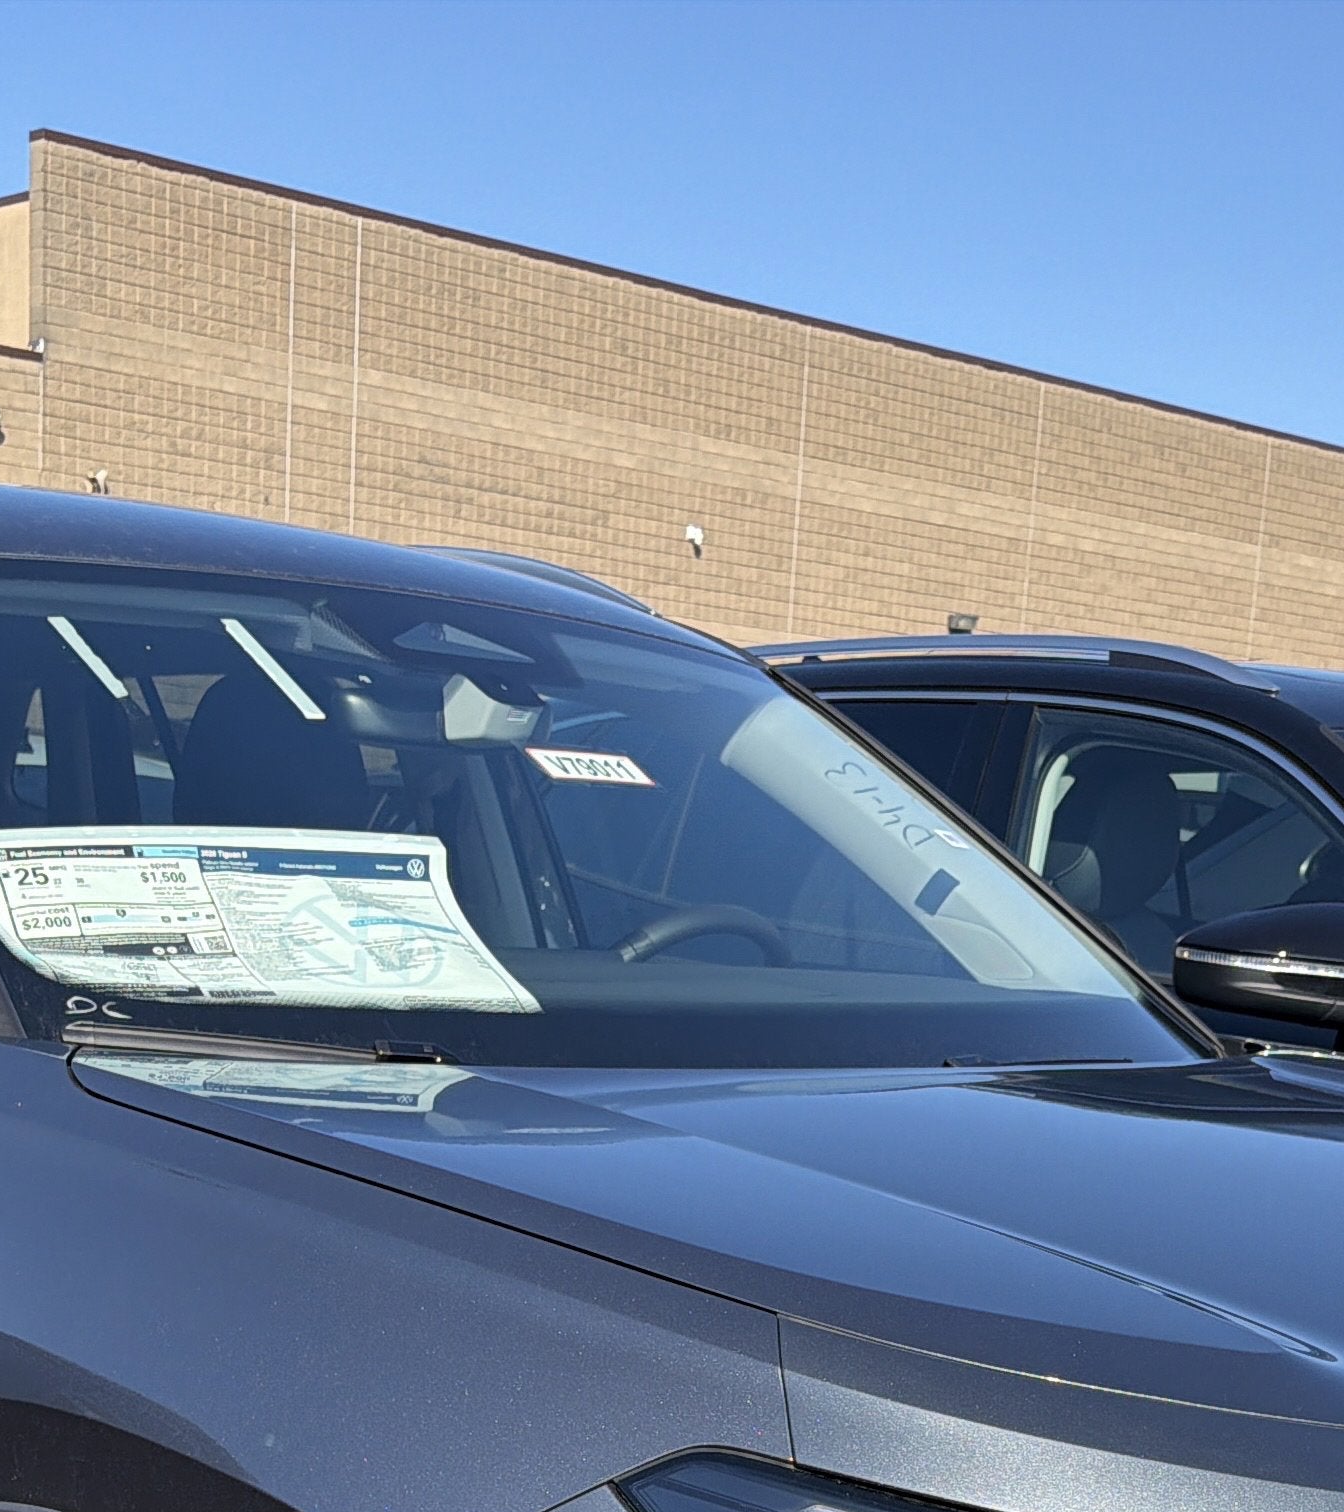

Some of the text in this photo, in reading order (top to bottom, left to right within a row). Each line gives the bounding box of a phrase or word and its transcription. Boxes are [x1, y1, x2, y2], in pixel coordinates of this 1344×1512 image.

[544, 755, 636, 780] V79011
[150, 861, 180, 870] spend
[14, 866, 50, 886] 25
[140, 871, 186, 884] $1,500
[22, 915, 72, 931] $2,000
